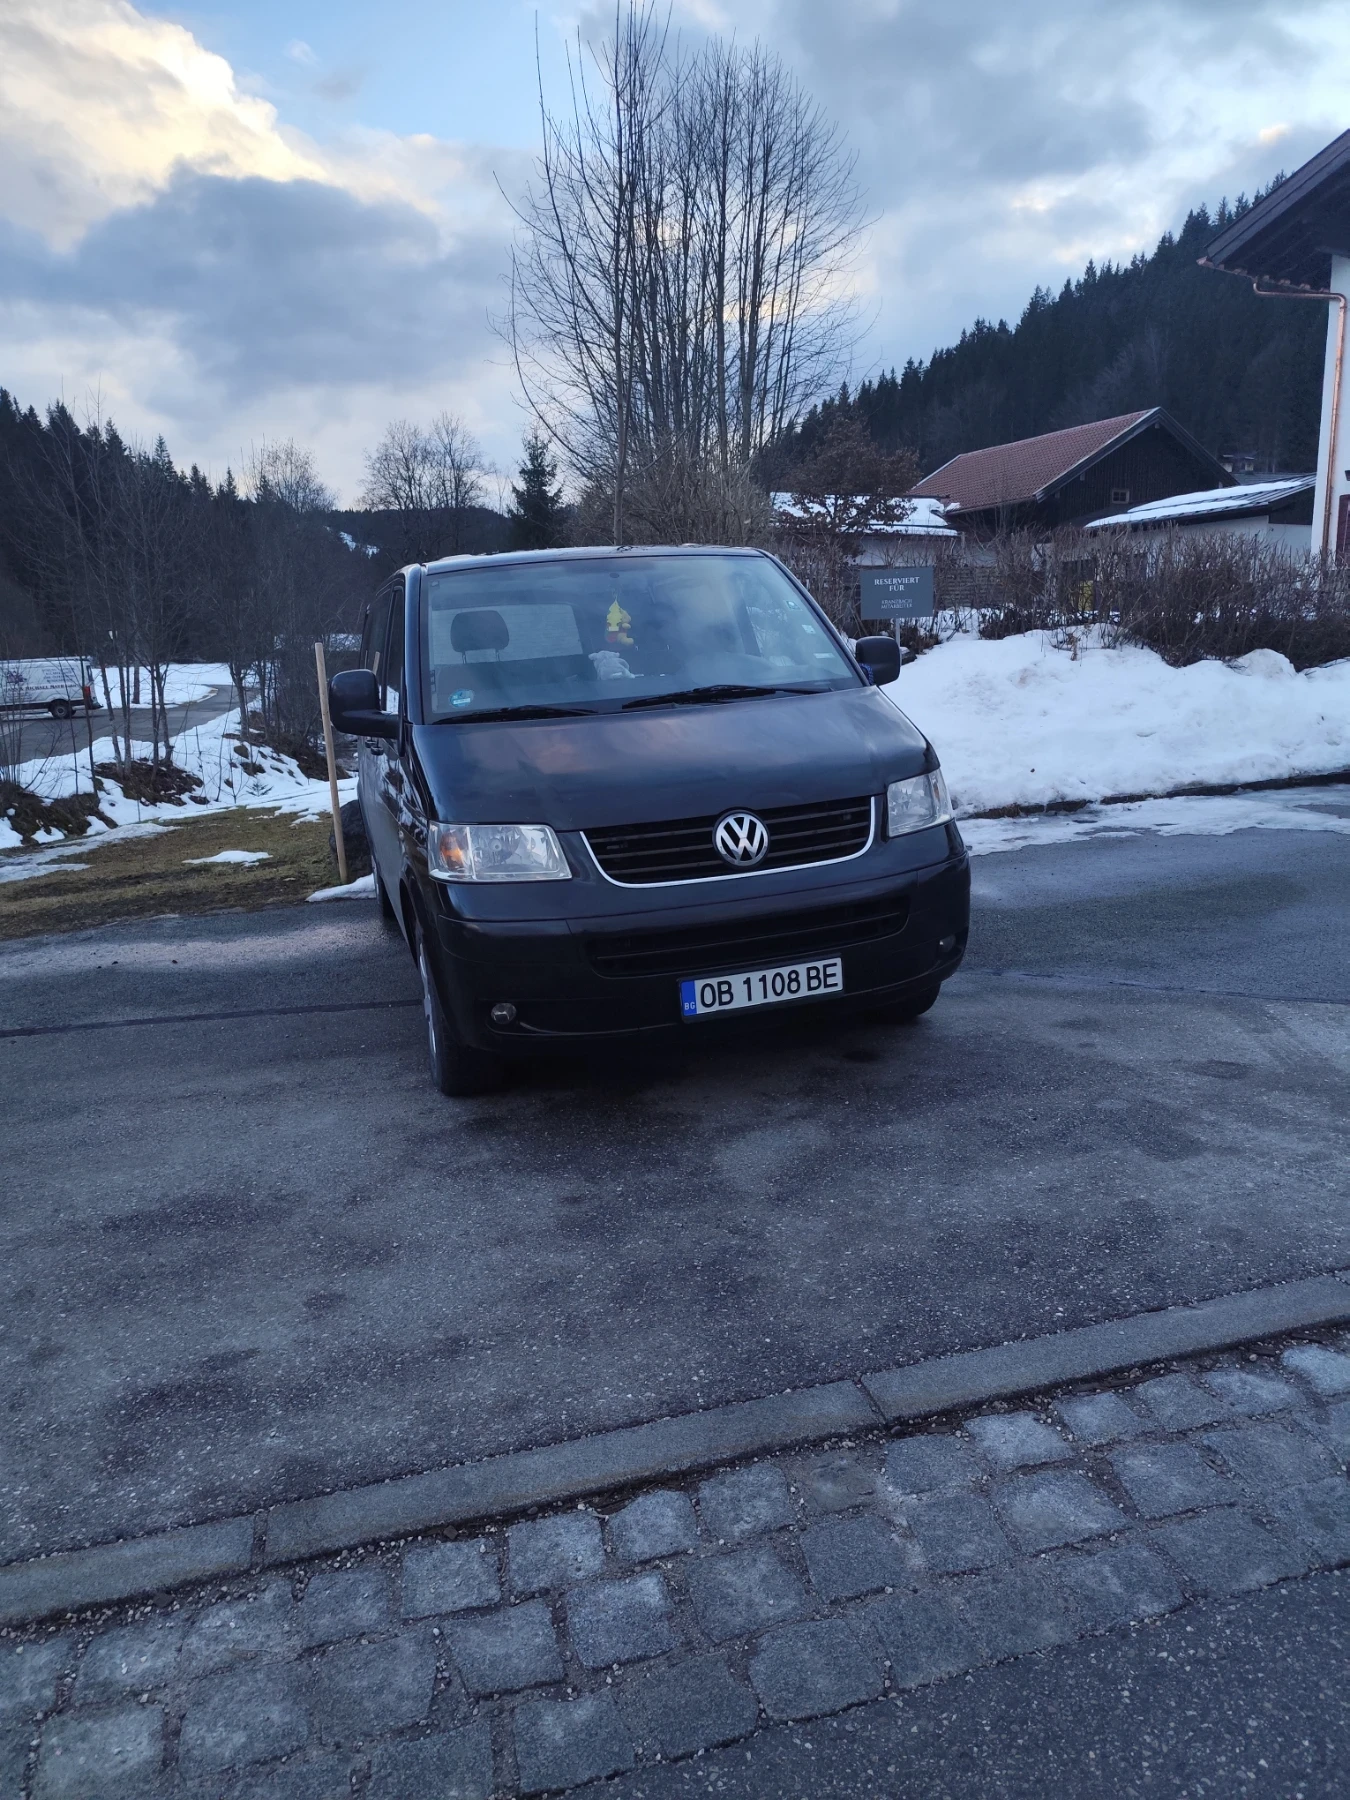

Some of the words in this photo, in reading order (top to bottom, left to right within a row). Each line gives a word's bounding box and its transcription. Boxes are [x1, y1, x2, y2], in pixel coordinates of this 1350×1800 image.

[874, 576, 920, 586] RESERVIERT
[889, 583, 905, 592] FÜR
[715, 813, 768, 867] VW
[700, 980, 734, 1008] OB
[742, 969, 801, 1002] 1108
[806, 962, 839, 992] BE
[684, 1001, 696, 1011] BG
